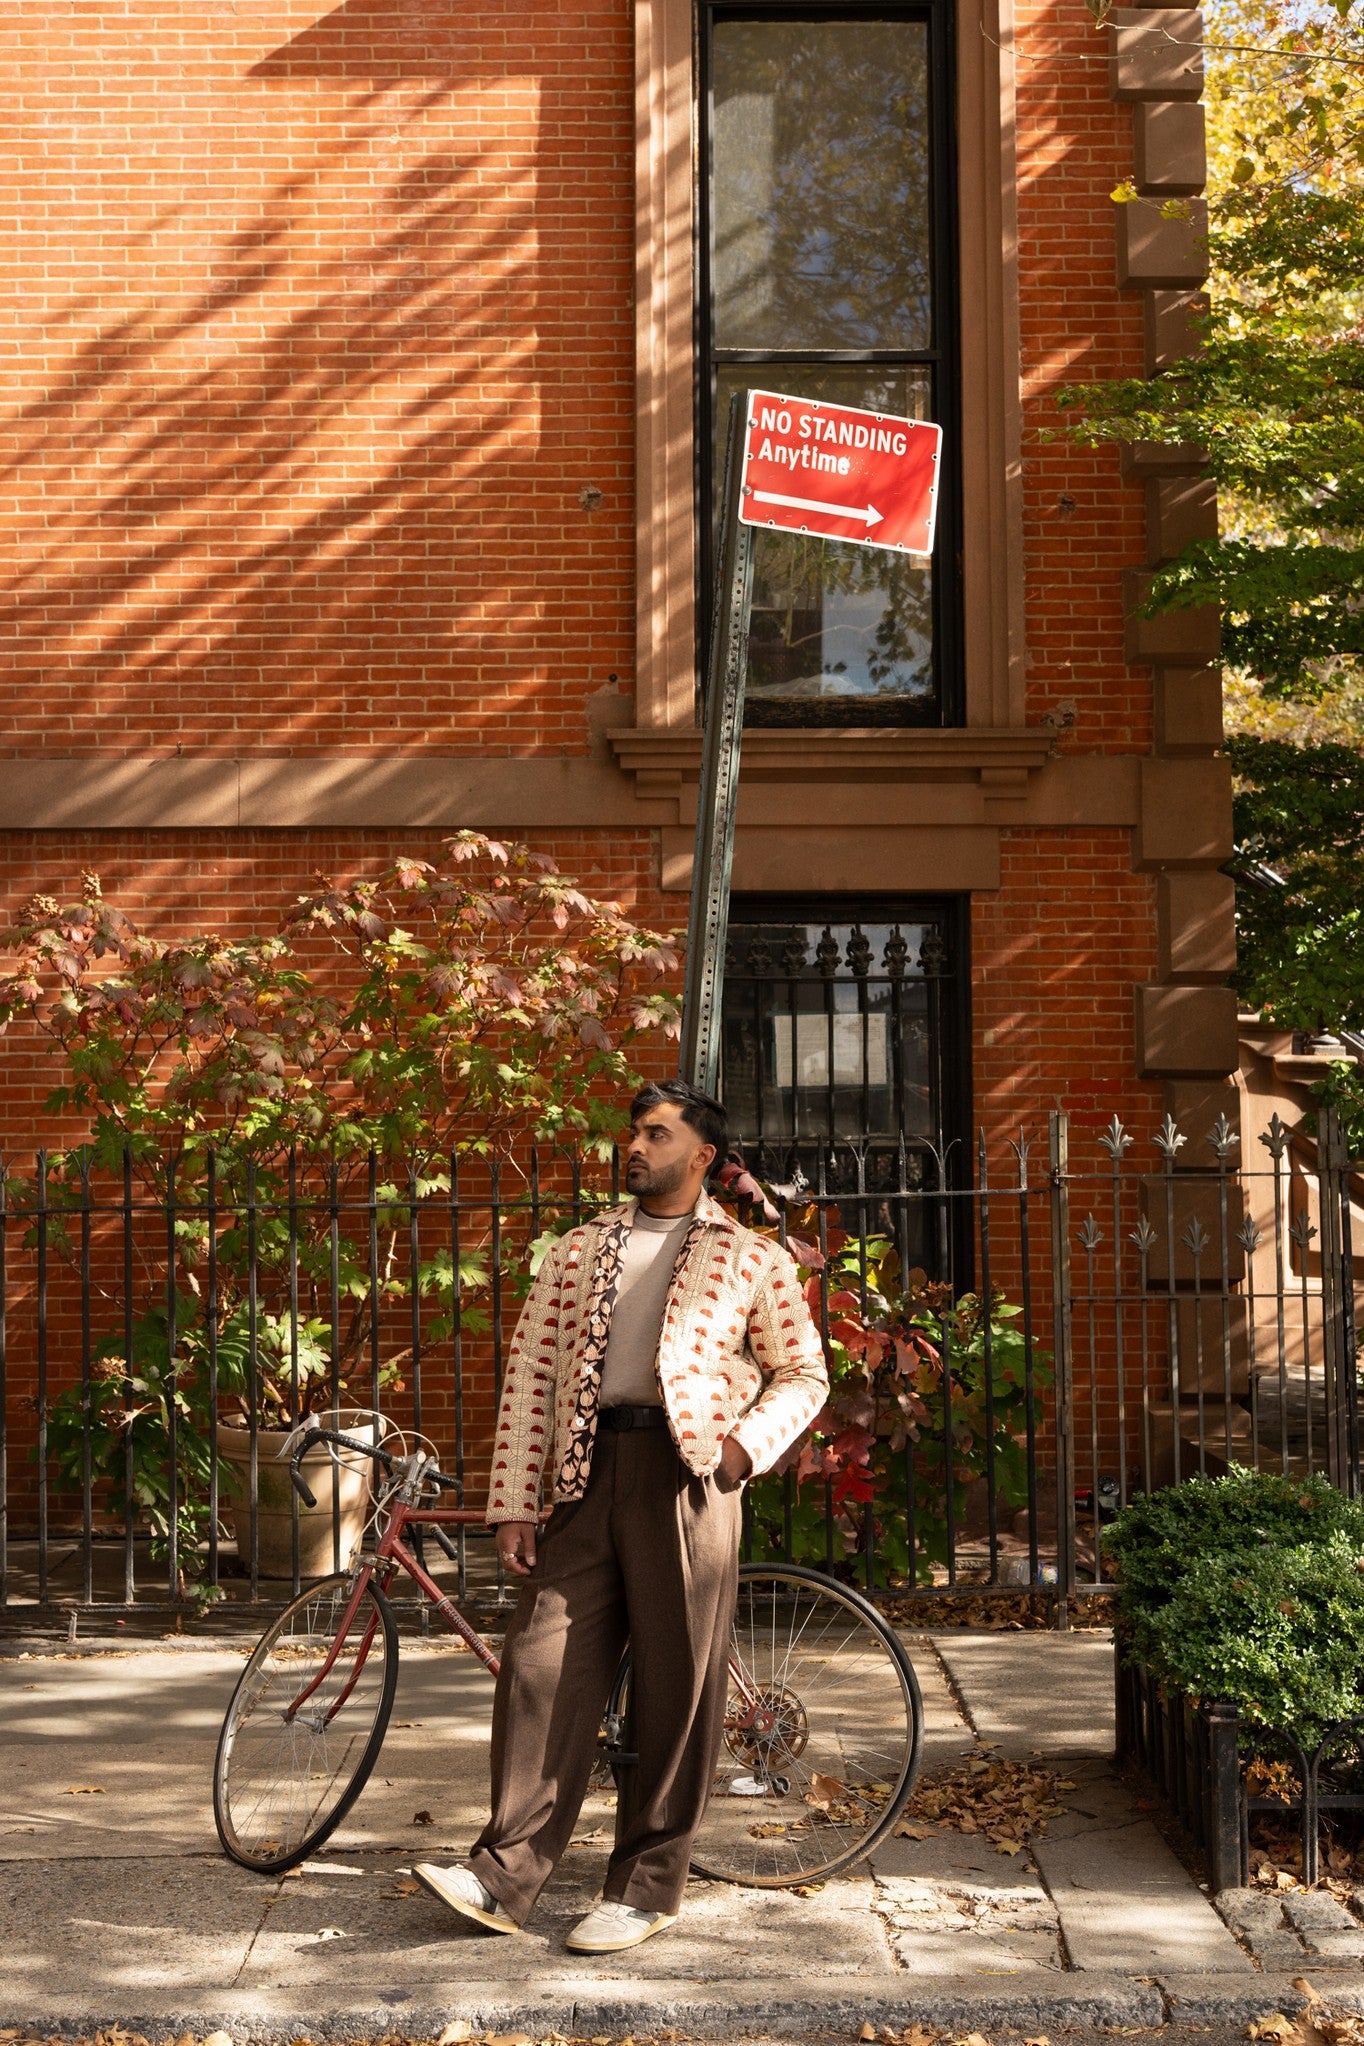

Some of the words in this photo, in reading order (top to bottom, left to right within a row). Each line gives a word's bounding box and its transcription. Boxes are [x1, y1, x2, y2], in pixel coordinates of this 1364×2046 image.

[760, 407, 792, 434] NO
[798, 415, 907, 456] STANDING
[757, 438, 850, 475] Anytime
